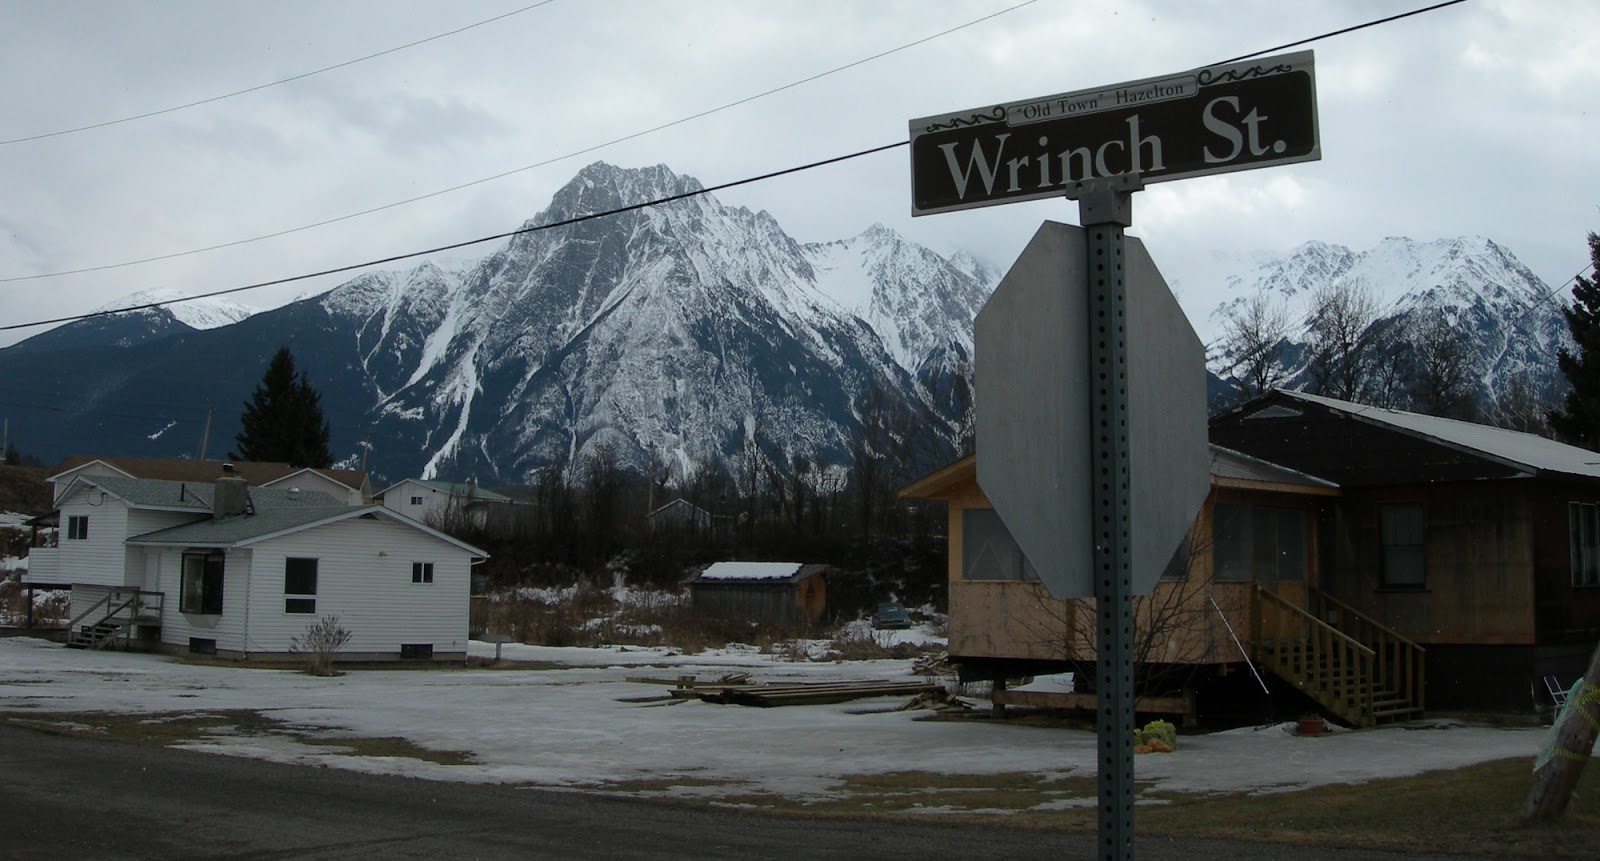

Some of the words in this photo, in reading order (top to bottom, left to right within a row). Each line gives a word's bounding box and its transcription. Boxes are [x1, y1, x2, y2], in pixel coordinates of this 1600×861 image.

[1115, 85, 1184, 104] Hazelton
[938, 114, 1166, 199] Wrinch
[1202, 96, 1287, 163] St.
